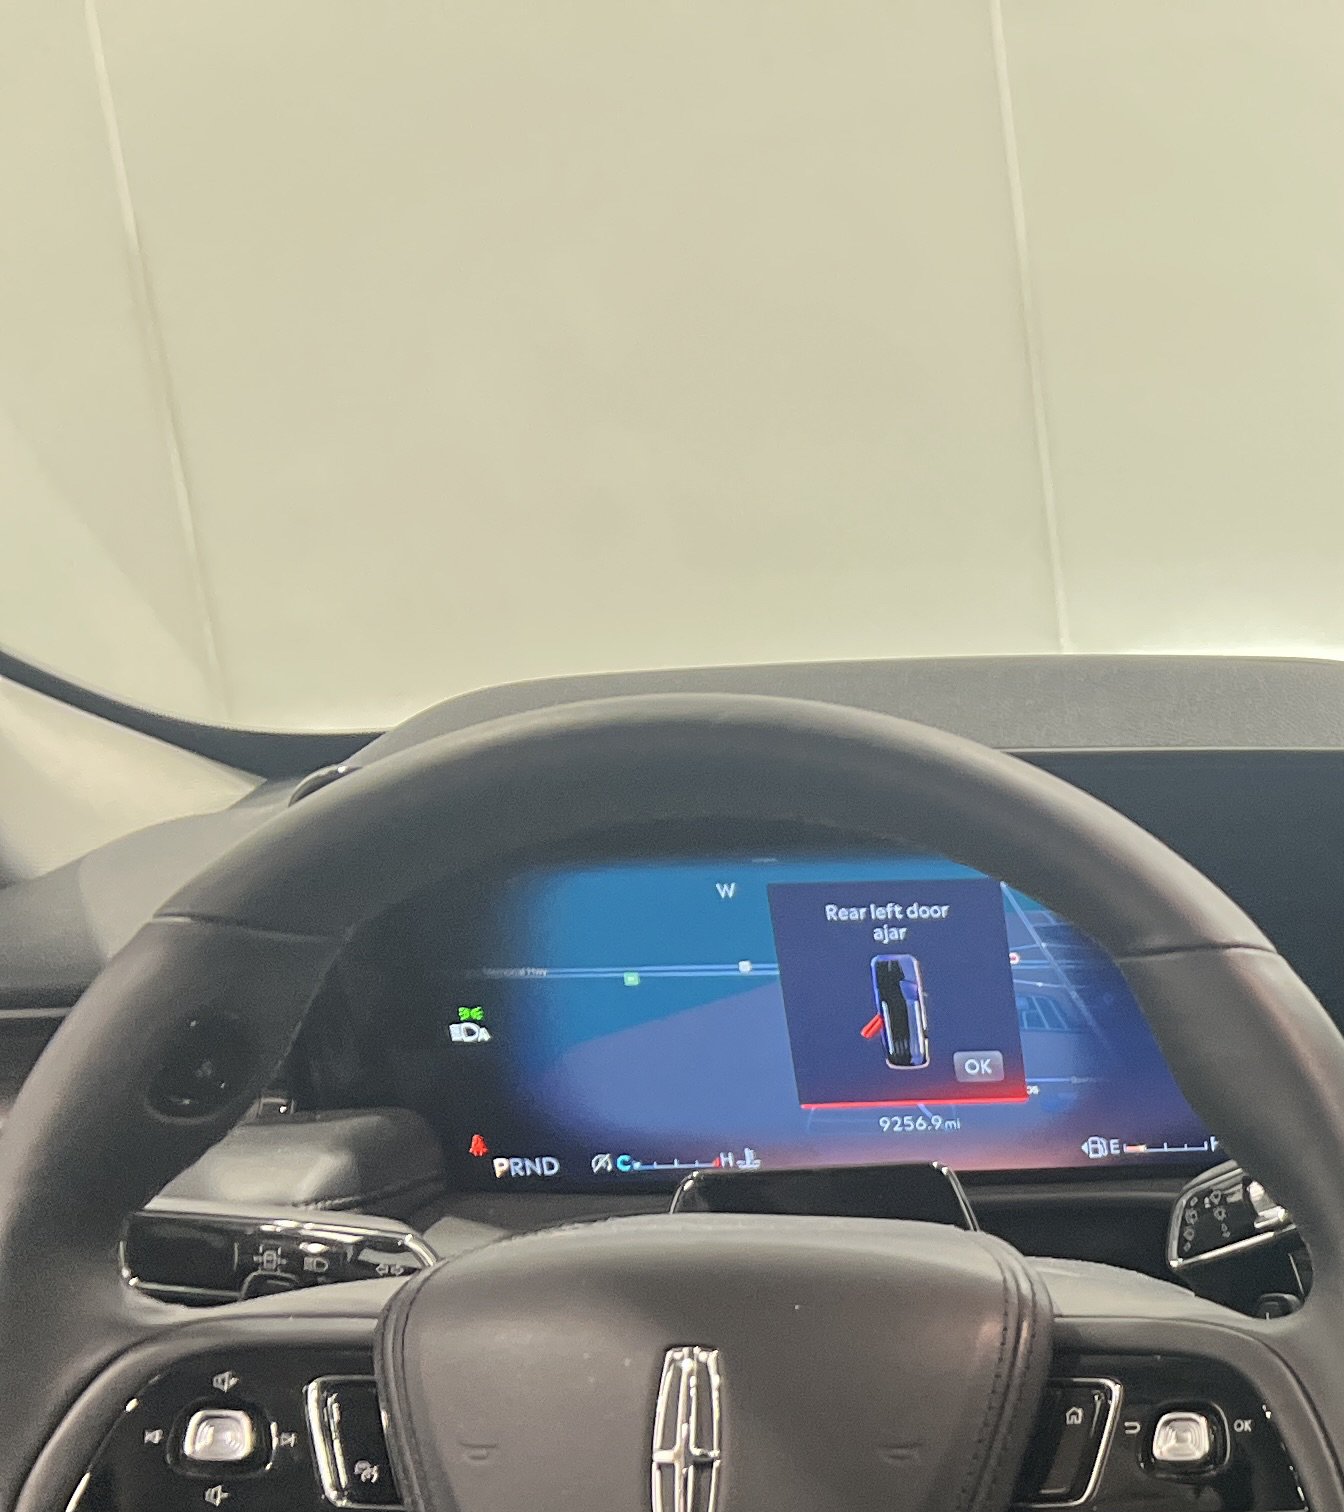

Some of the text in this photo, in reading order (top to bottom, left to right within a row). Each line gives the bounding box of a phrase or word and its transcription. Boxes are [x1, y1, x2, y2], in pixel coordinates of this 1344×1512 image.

[715, 882, 737, 899] W
[825, 902, 950, 922] Rear left door
[873, 924, 907, 944] ajar
[964, 1058, 992, 1075] OK
[878, 1115, 961, 1131] 9256.9 mi
[1109, 1138, 1121, 1154] E
[719, 1151, 733, 1168] H
[1234, 1419, 1252, 1432] OK
